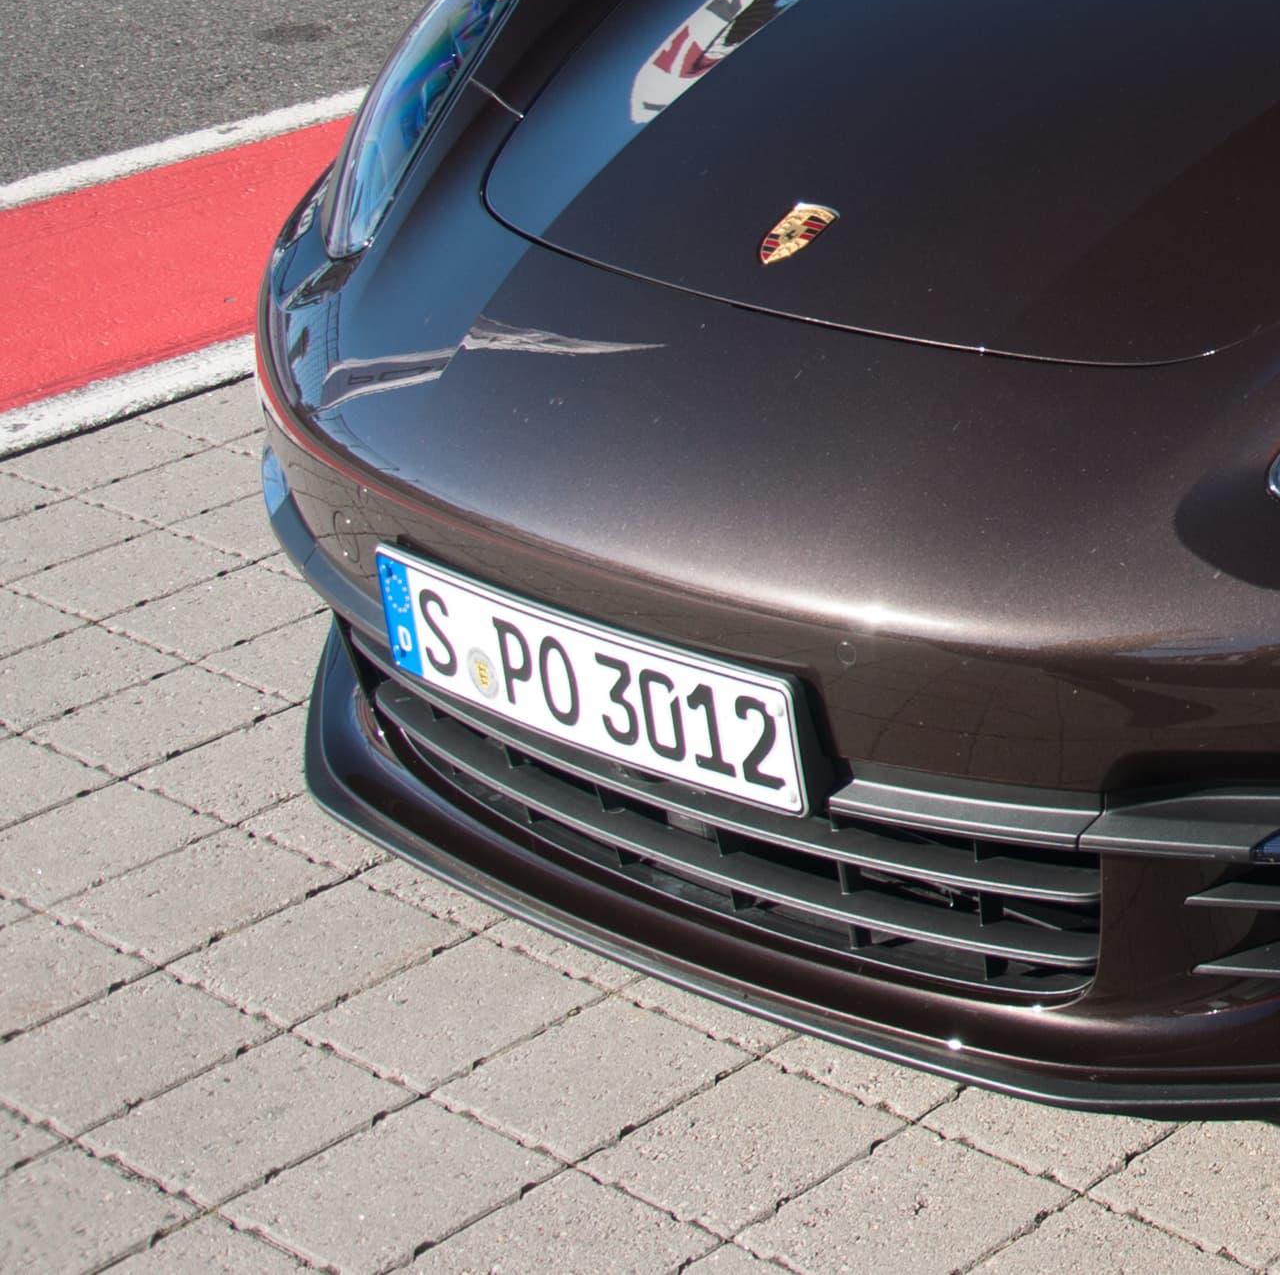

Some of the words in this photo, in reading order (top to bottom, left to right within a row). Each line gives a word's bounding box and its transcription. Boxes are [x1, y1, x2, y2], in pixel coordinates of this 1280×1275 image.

[418, 588, 459, 678] S
[491, 616, 580, 727] PO
[594, 651, 787, 791] 3012
